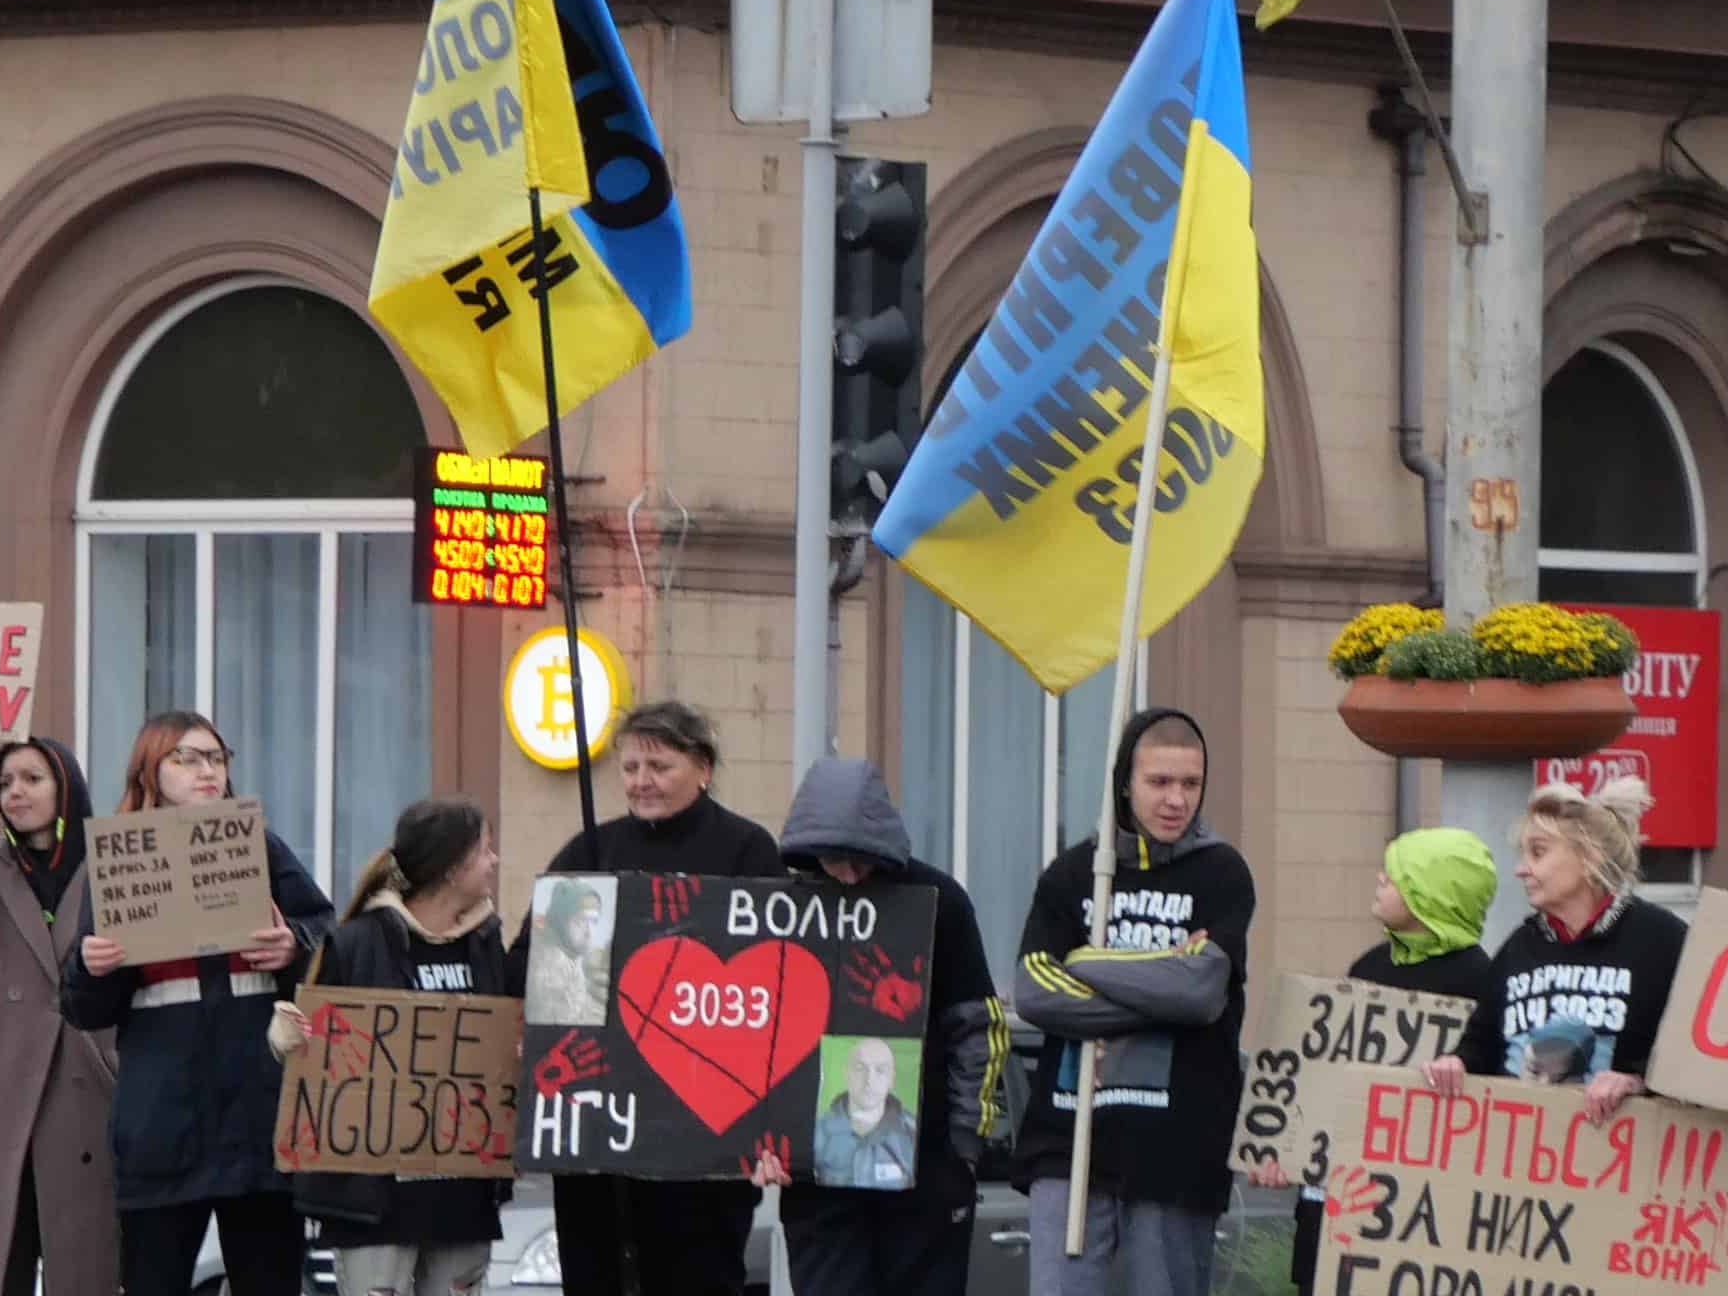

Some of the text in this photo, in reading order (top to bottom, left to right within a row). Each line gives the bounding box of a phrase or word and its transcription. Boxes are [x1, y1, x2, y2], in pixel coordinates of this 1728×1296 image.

[95, 816, 255, 858] FREE AZOV
[727, 890, 877, 940] ВОЛЮ
[1531, 964, 1631, 995] БРИГАДА
[669, 981, 770, 1028] 3033
[324, 1004, 493, 1078] FREE
[532, 1089, 636, 1160] НГУ
[1359, 1172, 1575, 1264] ЗА НИХ
[1633, 1201, 1712, 1250] ЯК
[1608, 1241, 1719, 1286] ВОНИ
